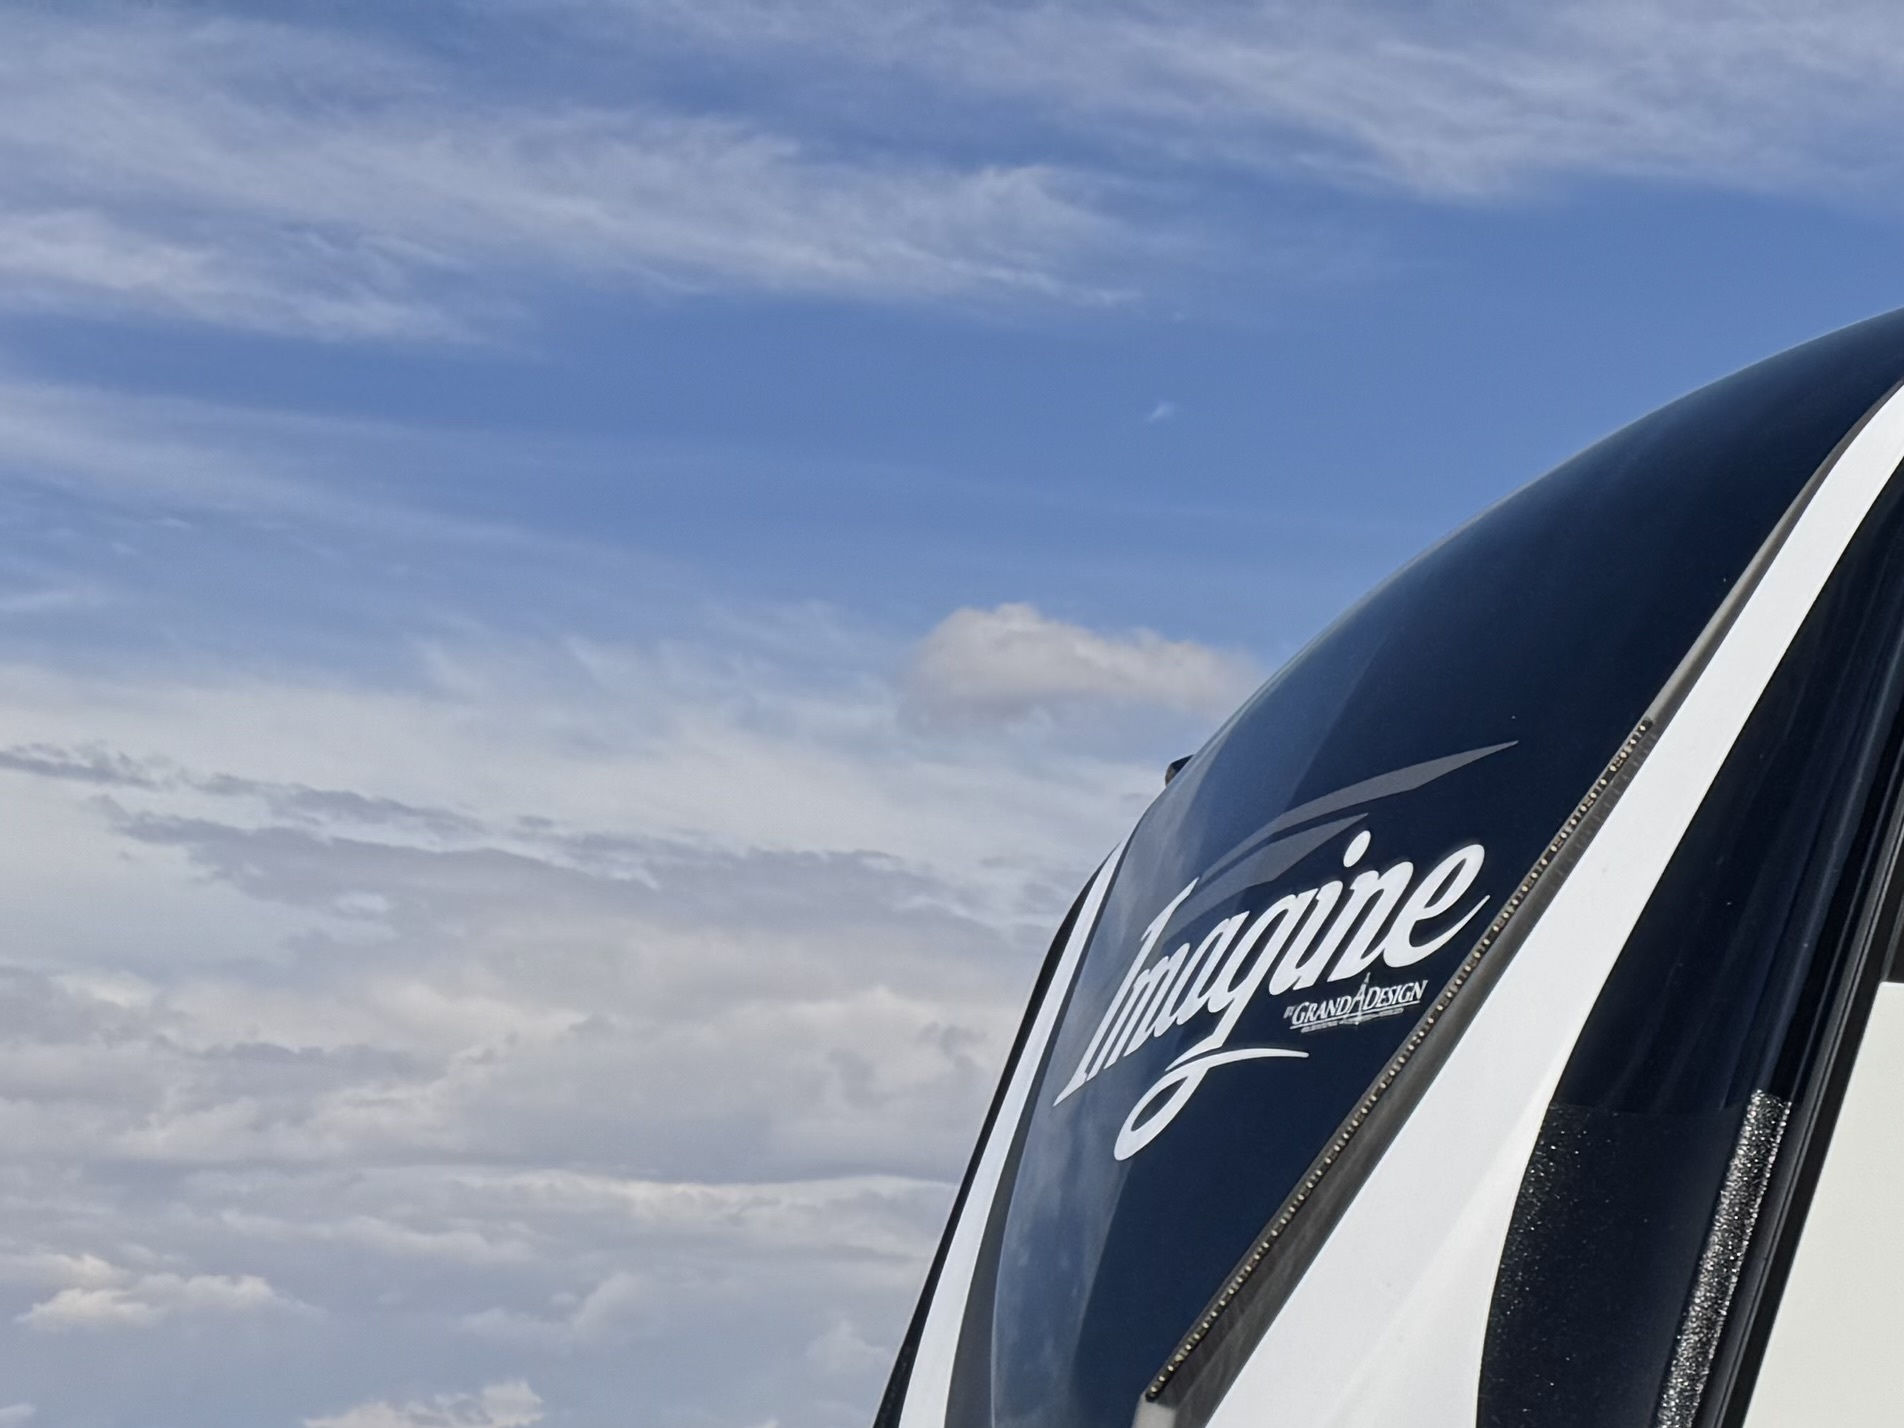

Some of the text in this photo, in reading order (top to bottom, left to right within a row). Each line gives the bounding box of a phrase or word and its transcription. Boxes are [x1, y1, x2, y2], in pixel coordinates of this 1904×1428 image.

[1053, 830, 1491, 1162] Imagine
[1291, 995, 1352, 1025] GRAND
[1363, 980, 1429, 1010] DESIGN
